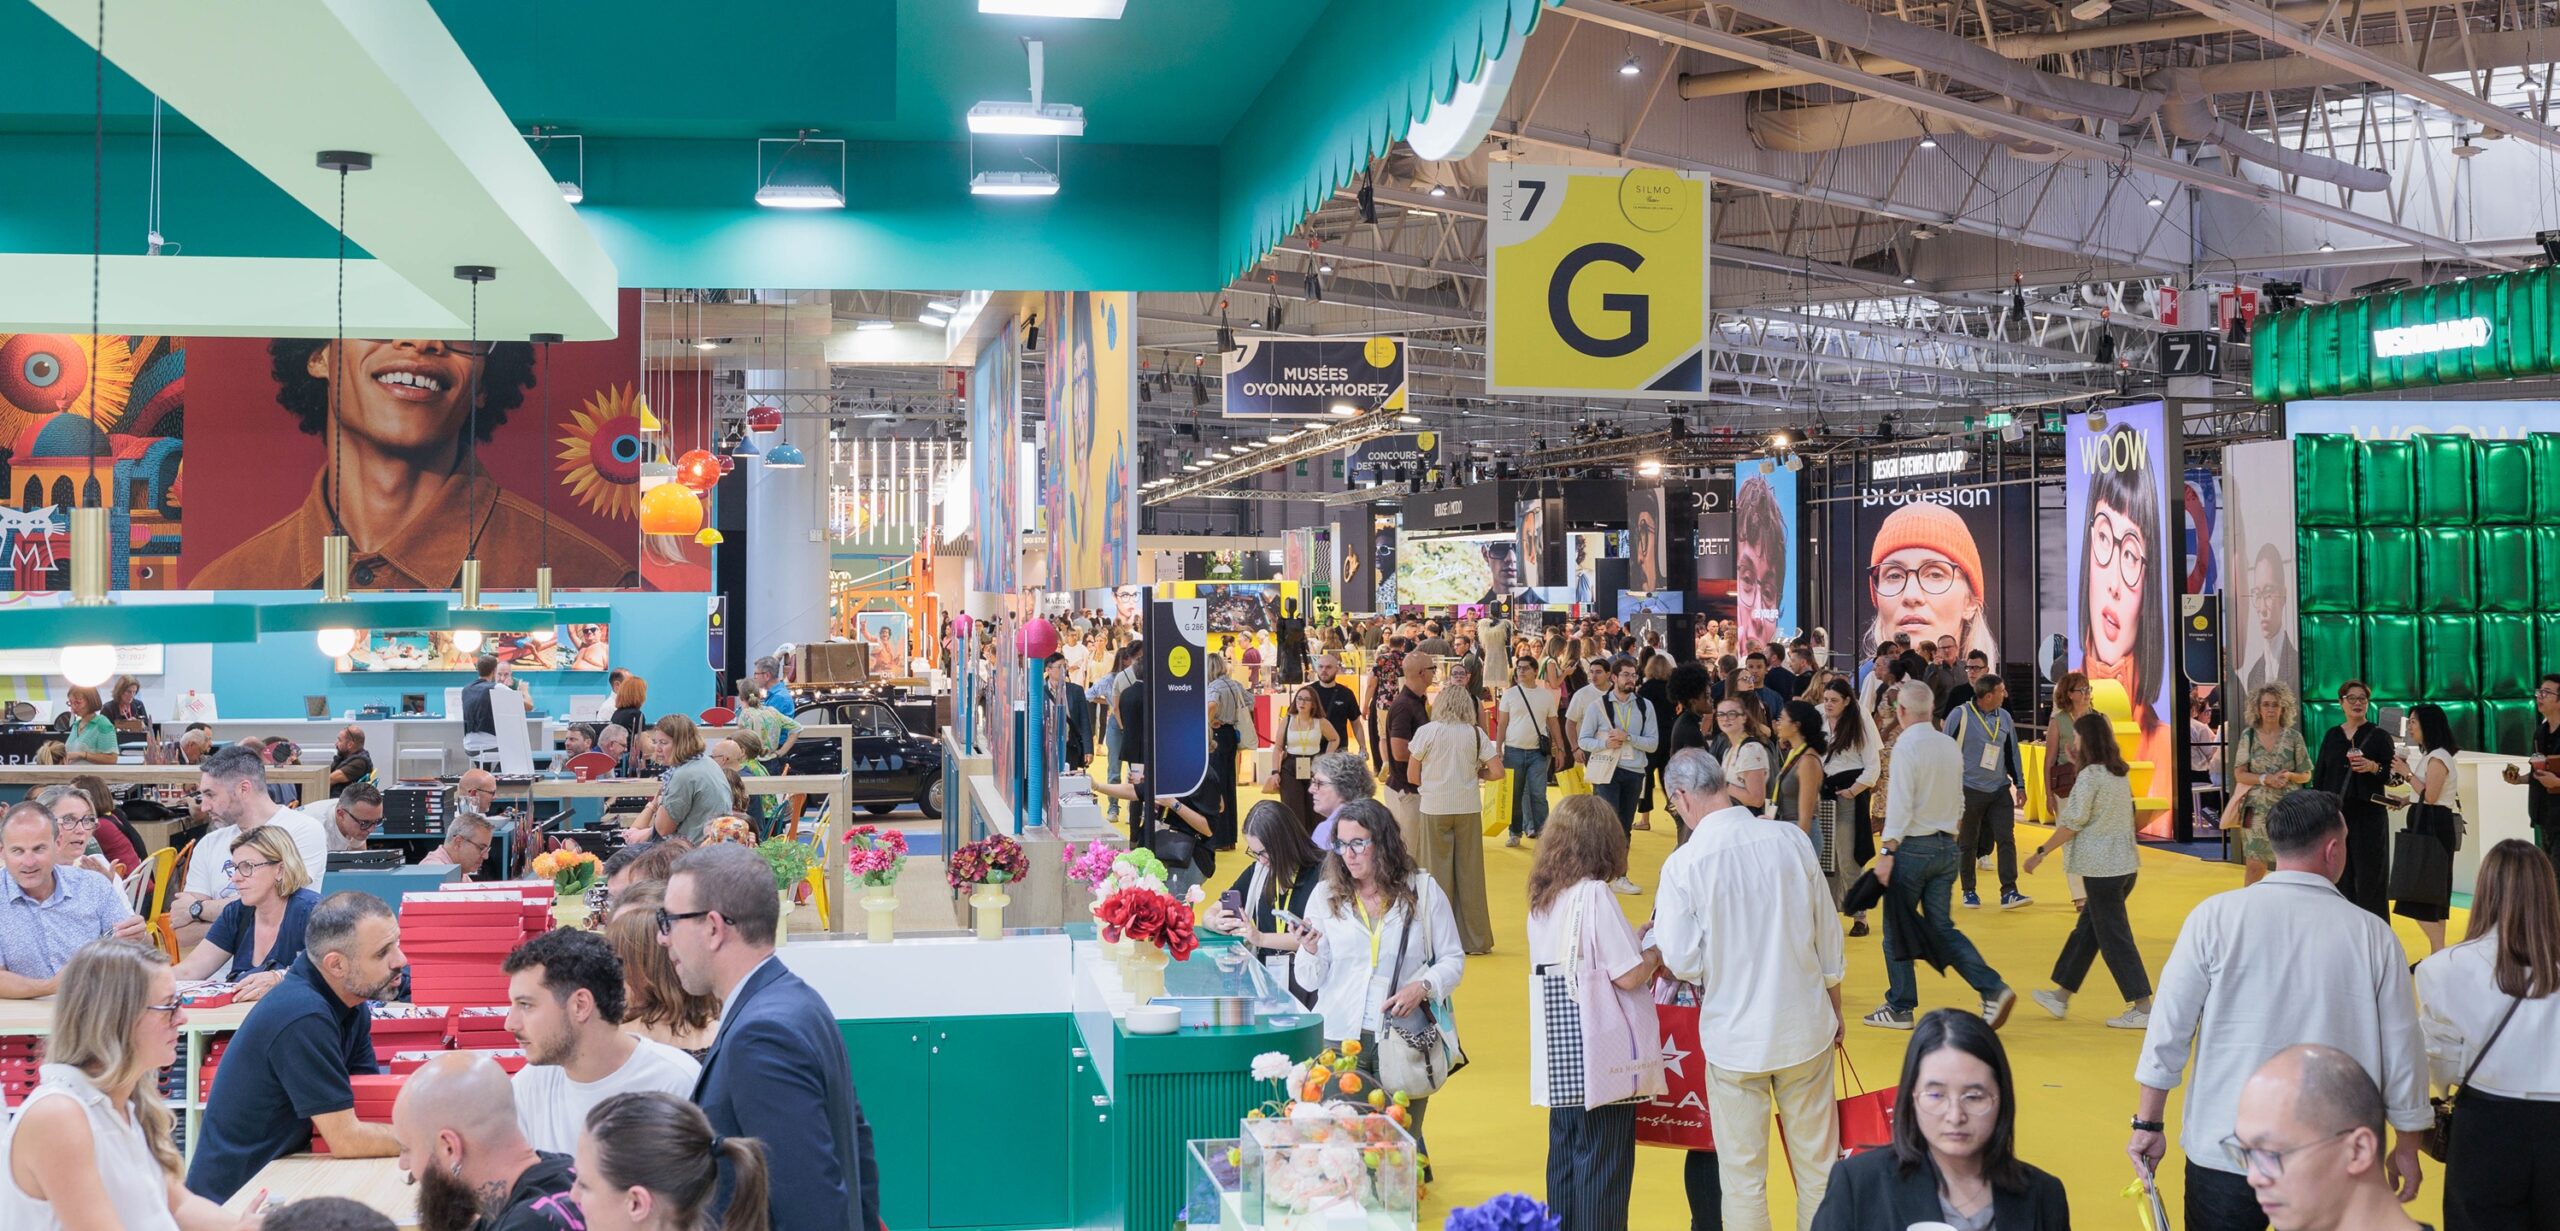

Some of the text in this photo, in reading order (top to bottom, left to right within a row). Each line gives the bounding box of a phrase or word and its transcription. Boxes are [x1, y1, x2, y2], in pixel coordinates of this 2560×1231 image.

[1636, 185, 1671, 195] SILMO
[1503, 182, 1513, 221] HALL
[1518, 180, 1546, 222] 7
[1548, 242, 1649, 358] G
[1236, 344, 1248, 363] 7
[2169, 344, 2191, 371] 7
[2206, 344, 2217, 371] 7
[1284, 364, 1349, 381] MUSÉES
[1243, 383, 1389, 397] OYONNAX-MOREZ
[1368, 450, 1417, 461] CONCOURS
[2080, 429, 2149, 475] WOOW
[1872, 450, 1966, 480] DESIGN EYEWEAR GROUP
[1862, 483, 1991, 508] prodesign
[1698, 537, 1730, 555] BRETT
[1192, 606, 1201, 620] 7
[1184, 623, 1205, 631] G 286
[1168, 683, 1192, 692] Woodys
[1609, 1066, 1623, 1074] Ana
